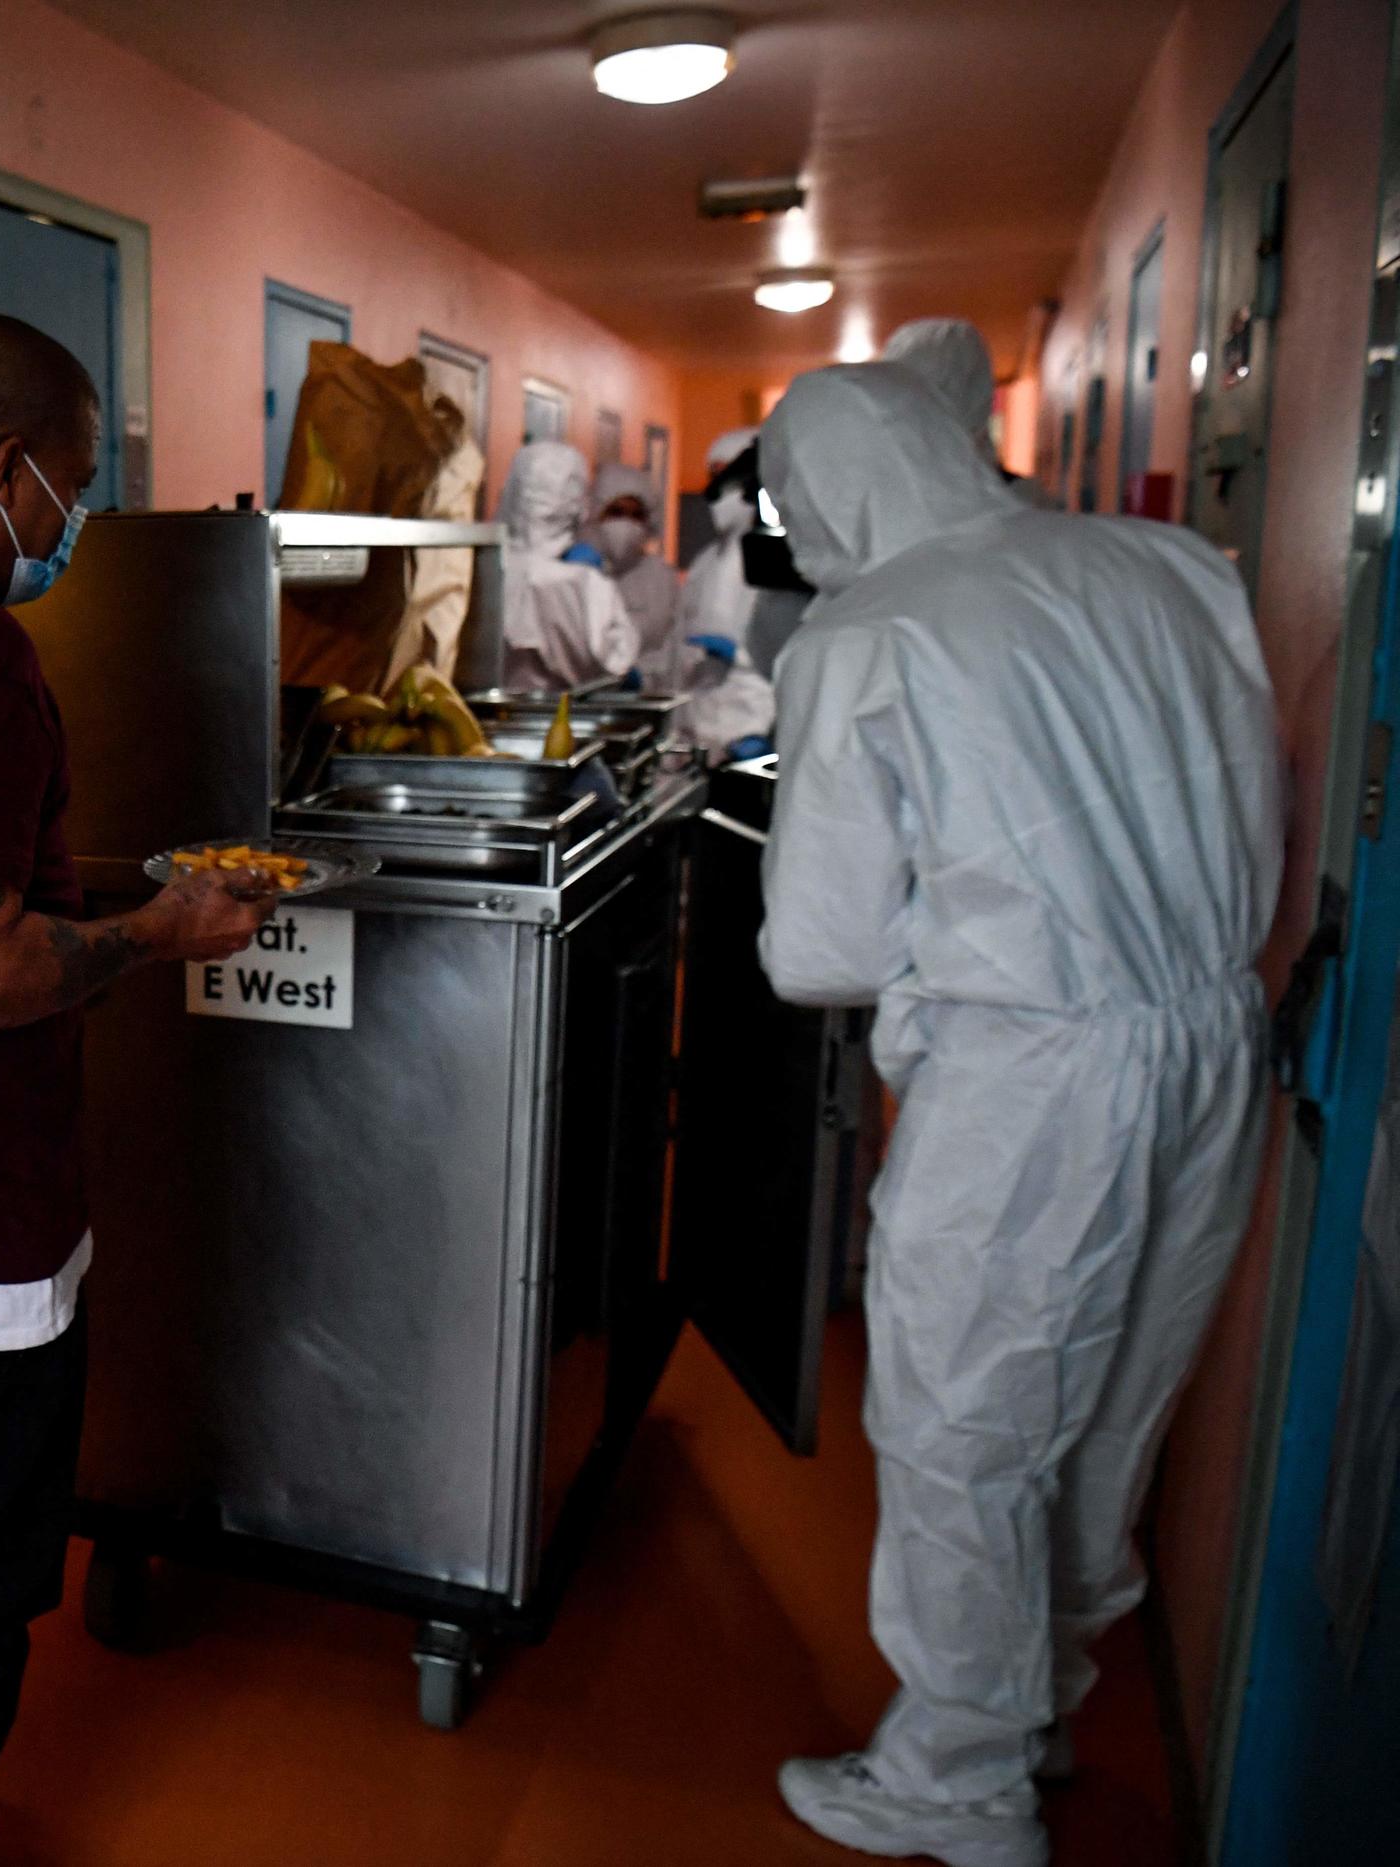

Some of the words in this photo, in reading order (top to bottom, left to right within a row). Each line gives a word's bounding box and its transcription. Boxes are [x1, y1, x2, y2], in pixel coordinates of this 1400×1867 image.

[256, 917, 308, 954] at.
[204, 965, 223, 999] E
[236, 967, 337, 1010] West
